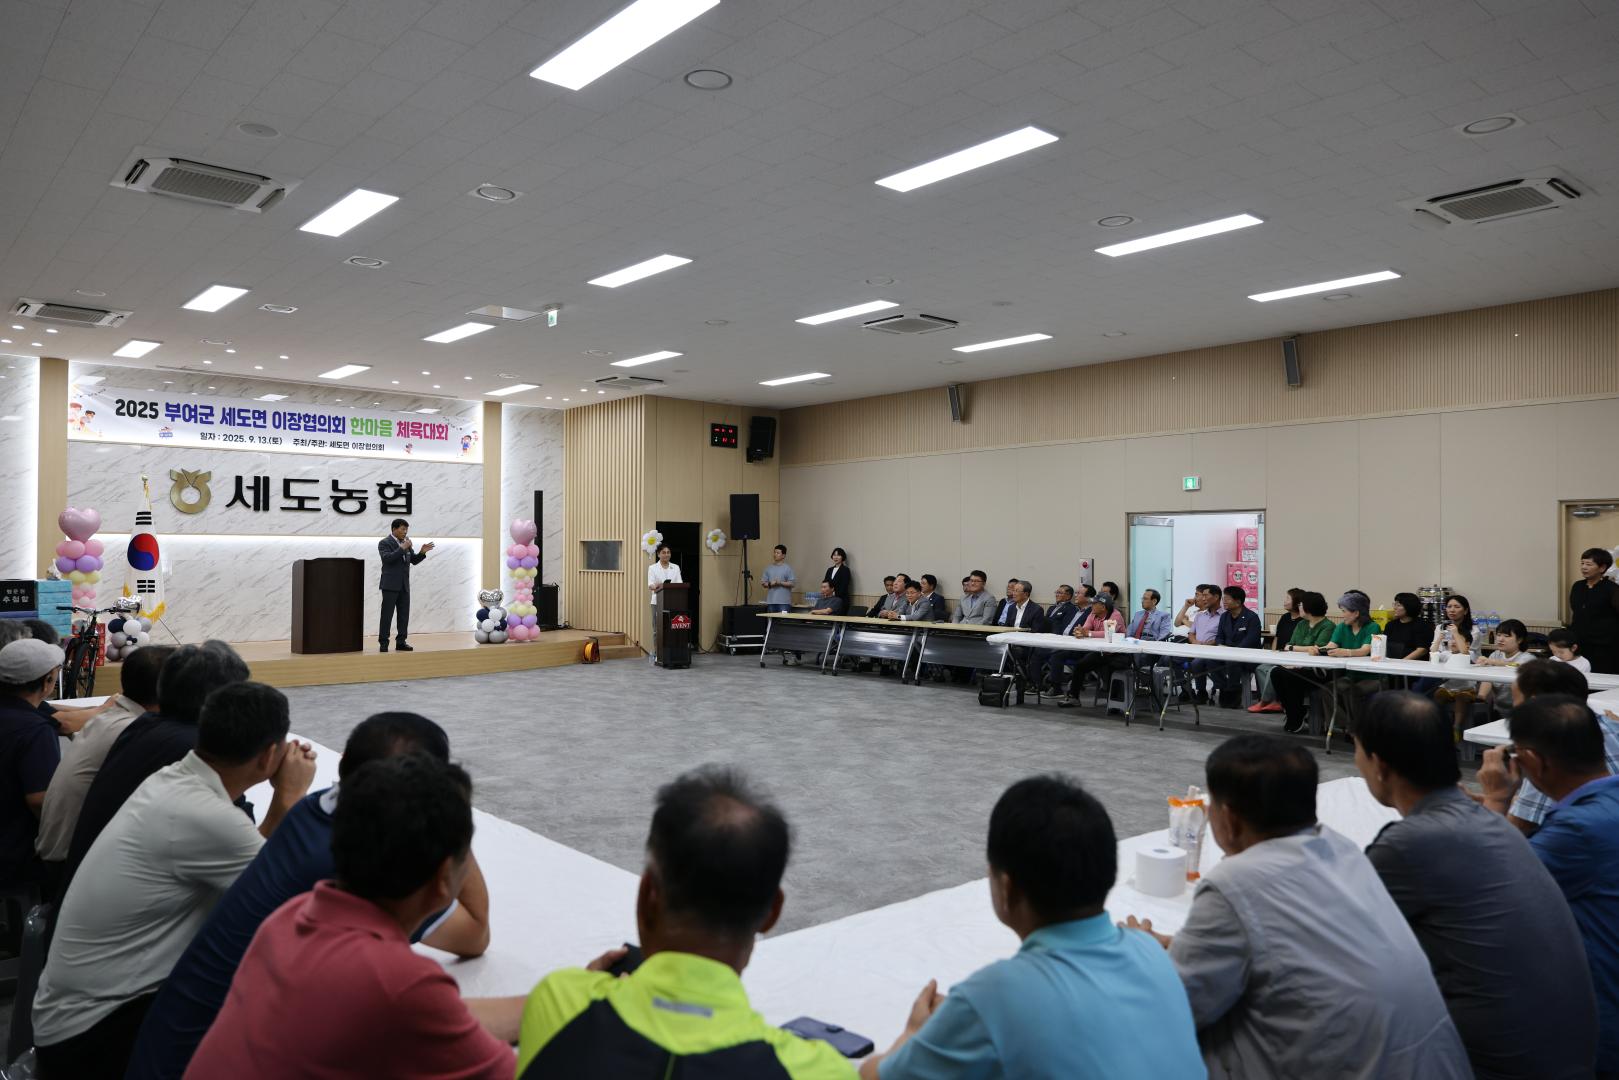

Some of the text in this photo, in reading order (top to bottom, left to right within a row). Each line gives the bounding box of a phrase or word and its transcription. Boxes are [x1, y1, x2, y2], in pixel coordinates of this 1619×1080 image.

[115, 399, 449, 441] 2025 부여군 세도면 이장협의회 한마음 체육대회
[200, 432, 216, 441] 일자
[223, 434, 247, 443] 2025.
[258, 436, 283, 445] 13.(토)
[293, 438, 327, 448] 주최/주관:
[329, 441, 350, 449] 세도면
[351, 442, 385, 451] 이장협의회
[225, 475, 412, 515] 세도농협
